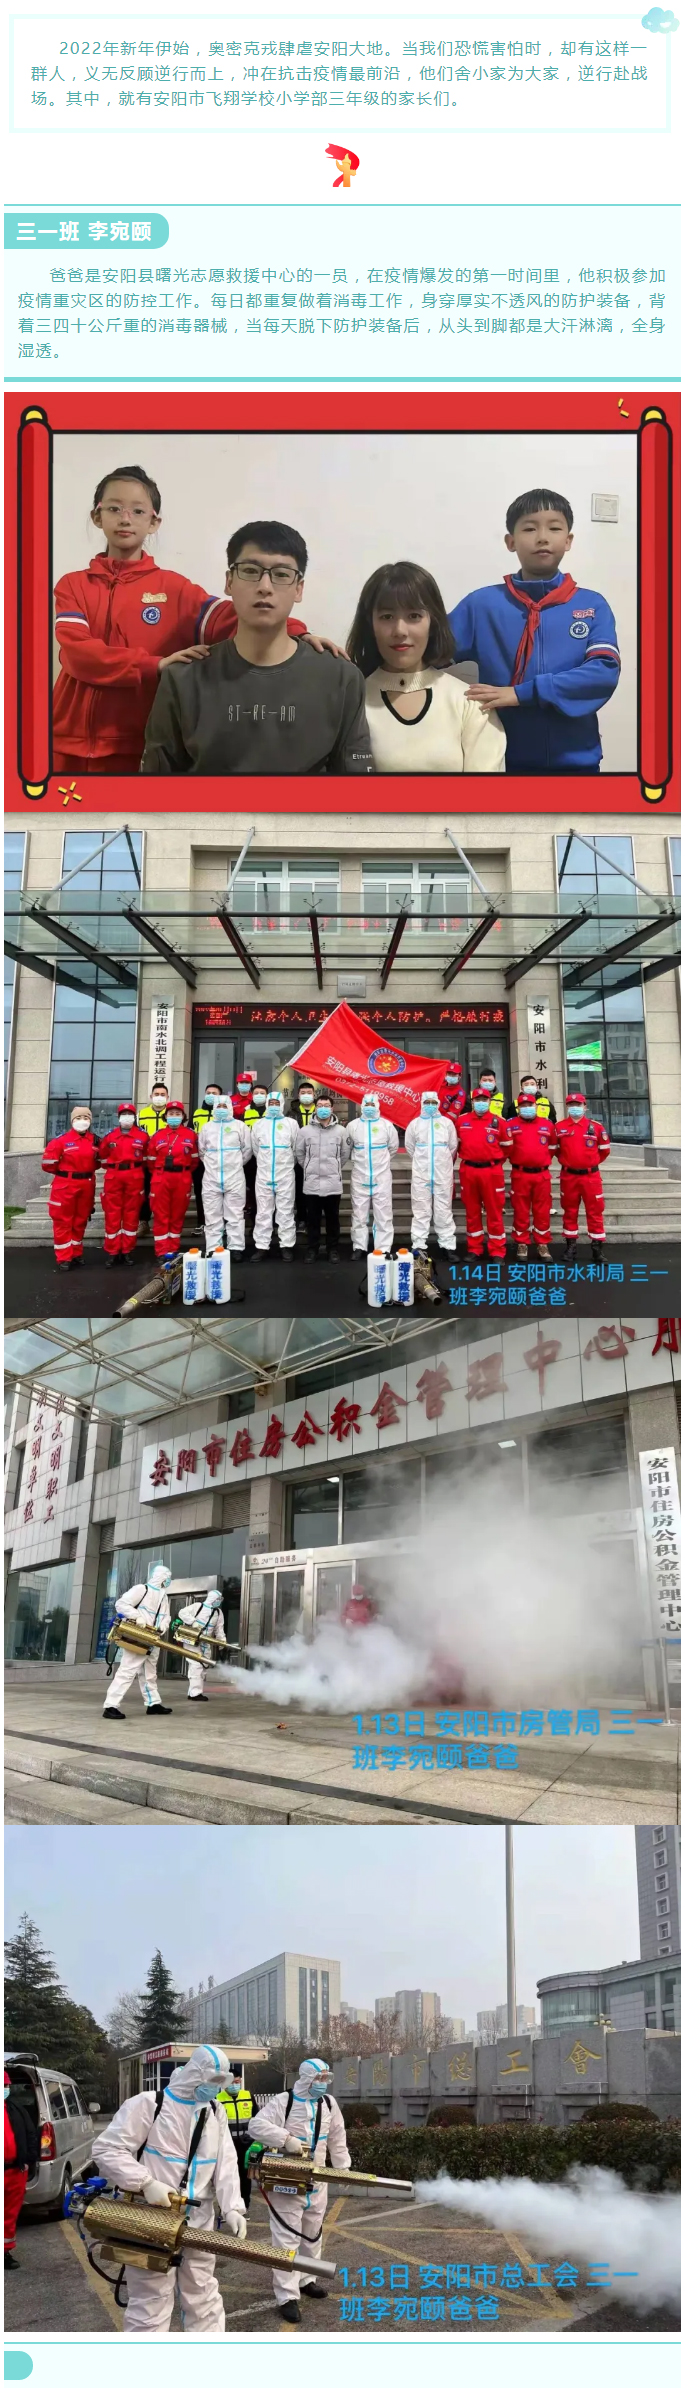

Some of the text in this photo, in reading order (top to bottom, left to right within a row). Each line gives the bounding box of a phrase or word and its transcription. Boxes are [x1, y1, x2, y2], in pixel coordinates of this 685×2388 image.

[153, 1002, 169, 1084] 安阳市南水北调工程运行
